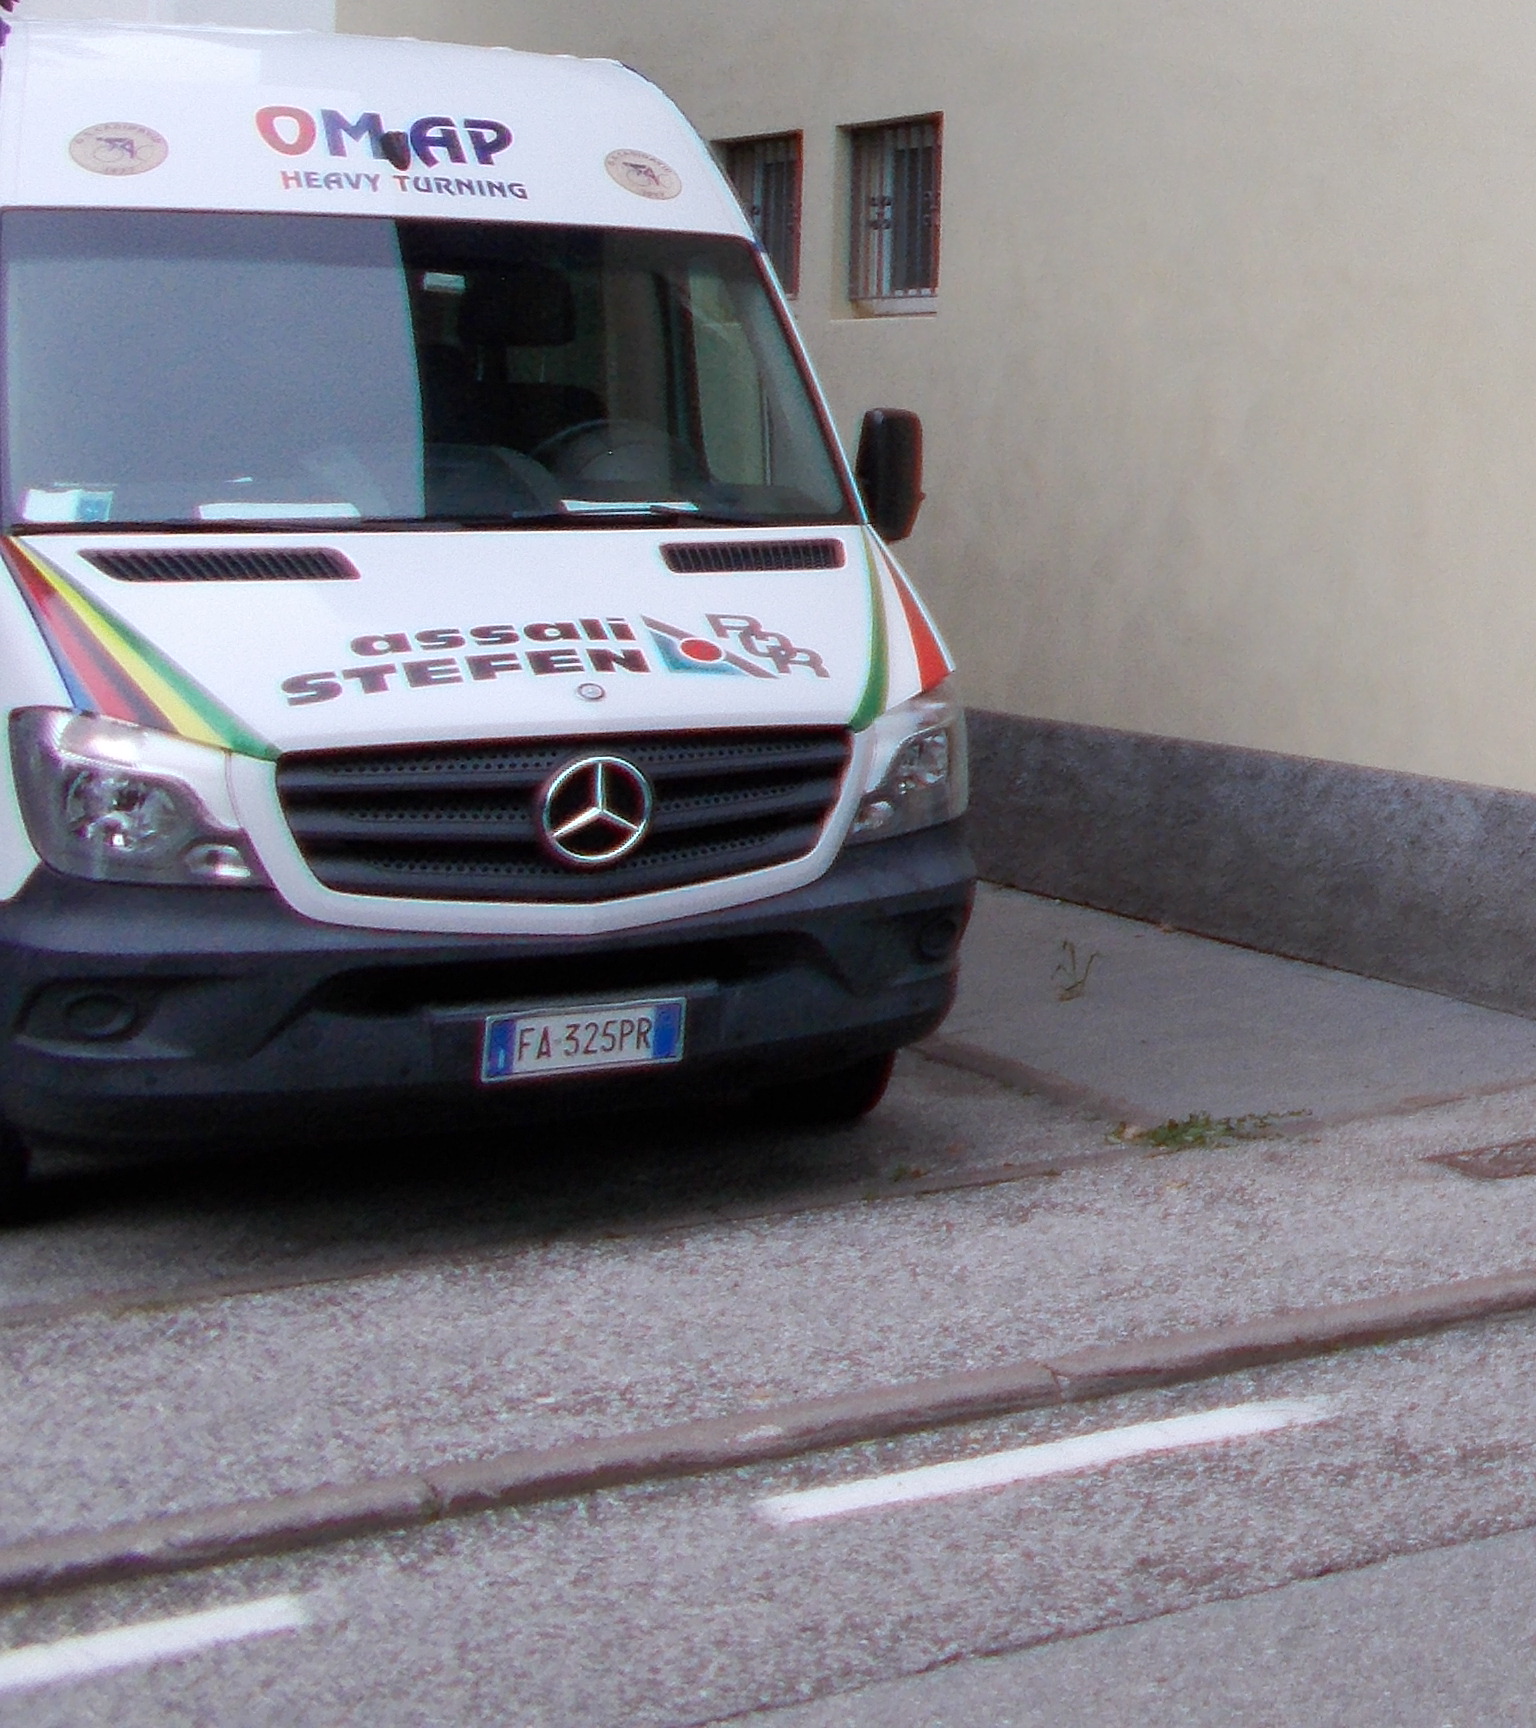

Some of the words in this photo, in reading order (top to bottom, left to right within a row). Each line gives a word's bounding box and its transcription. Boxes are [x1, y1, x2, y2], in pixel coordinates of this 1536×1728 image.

[280, 169, 381, 193] HEAVY
[391, 173, 529, 201] TURNING
[350, 617, 638, 658] assali
[280, 647, 652, 706] STEFEN
[517, 1025, 552, 1062] FA
[564, 1016, 653, 1057] 325PR
